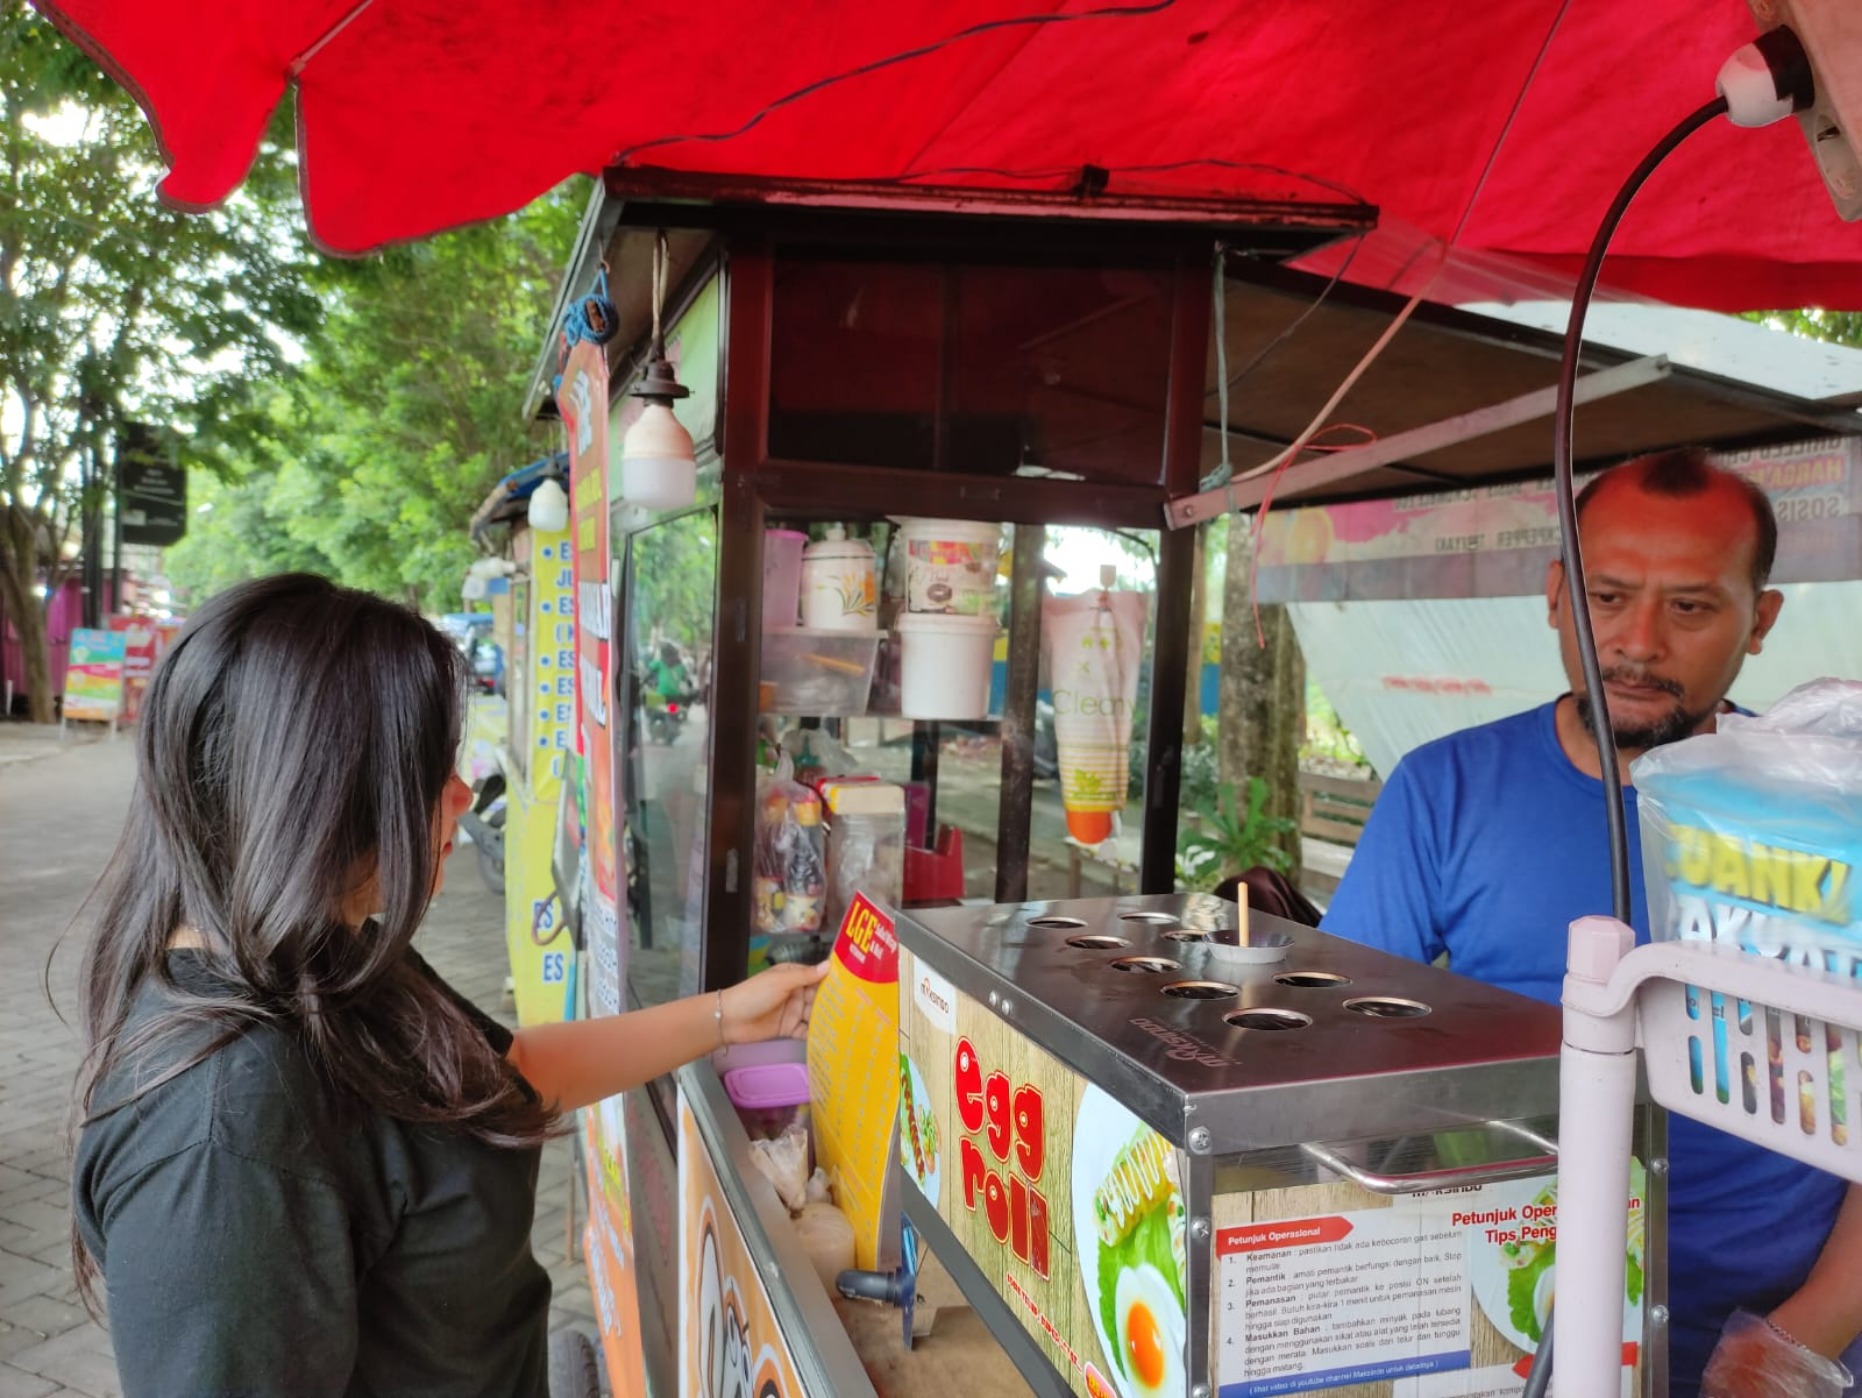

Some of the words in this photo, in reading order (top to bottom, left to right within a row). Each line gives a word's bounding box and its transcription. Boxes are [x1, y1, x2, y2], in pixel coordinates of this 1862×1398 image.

[544, 953, 564, 981] ES
[955, 1035, 1044, 1183] egg
[959, 1135, 1051, 1283] roll
[1452, 1208, 1516, 1226] Petunjuk
[1228, 1234, 1266, 1246] Petunjuk
[1269, 1227, 1321, 1241] Operasional
[1247, 1250, 1291, 1262] Keamanan
[1299, 1245, 1332, 1257] pastikan
[1355, 1240, 1370, 1249] ada
[1371, 1236, 1413, 1248] kebocoran
[1413, 1234, 1428, 1245] gas
[1485, 1229, 1516, 1245] Tips
[1246, 1273, 1286, 1285] Pemantik
[1317, 1264, 1353, 1277] pemantik
[1393, 1257, 1422, 1268] dengan
[1444, 1251, 1462, 1262] Stop
[1246, 1295, 1296, 1307] Pemanasan
[1334, 1285, 1370, 1298] pemantik
[1374, 1282, 1384, 1291] ke
[1416, 1277, 1429, 1286] ON
[1433, 1274, 1462, 1284] setelah
[1261, 1286, 1276, 1296] ada
[1277, 1282, 1304, 1294] bagian
[1305, 1280, 1324, 1292] yang
[1306, 1299, 1338, 1311] kira-kira
[1369, 1293, 1391, 1303] untuk
[1392, 1289, 1437, 1302] pemanasan
[1439, 1284, 1462, 1294] mesin
[1245, 1320, 1273, 1332] hingga
[1291, 1312, 1332, 1325] digunakan
[1245, 1330, 1289, 1342] Masukkan
[1293, 1325, 1321, 1336] Bahan
[1332, 1317, 1376, 1330] tambahkan
[1380, 1313, 1407, 1323] minyak
[1412, 1310, 1431, 1321] pada
[1436, 1306, 1461, 1317] lubang
[1244, 1343, 1276, 1355] dengan
[1276, 1335, 1333, 1349] menggunakan
[1355, 1329, 1372, 1338] atau
[1373, 1326, 1388, 1336] alat
[1389, 1324, 1409, 1335] yang
[1244, 1355, 1275, 1366] dengan
[1312, 1343, 1352, 1355] Masukkan
[1417, 1332, 1431, 1341] dan
[1434, 1329, 1461, 1341] tunggu
[1244, 1367, 1271, 1378] hingga
[1270, 1381, 1289, 1391] video
[1289, 1380, 1297, 1388] di
[1297, 1377, 1324, 1389] youtube
[1385, 1365, 1404, 1374] untuk
